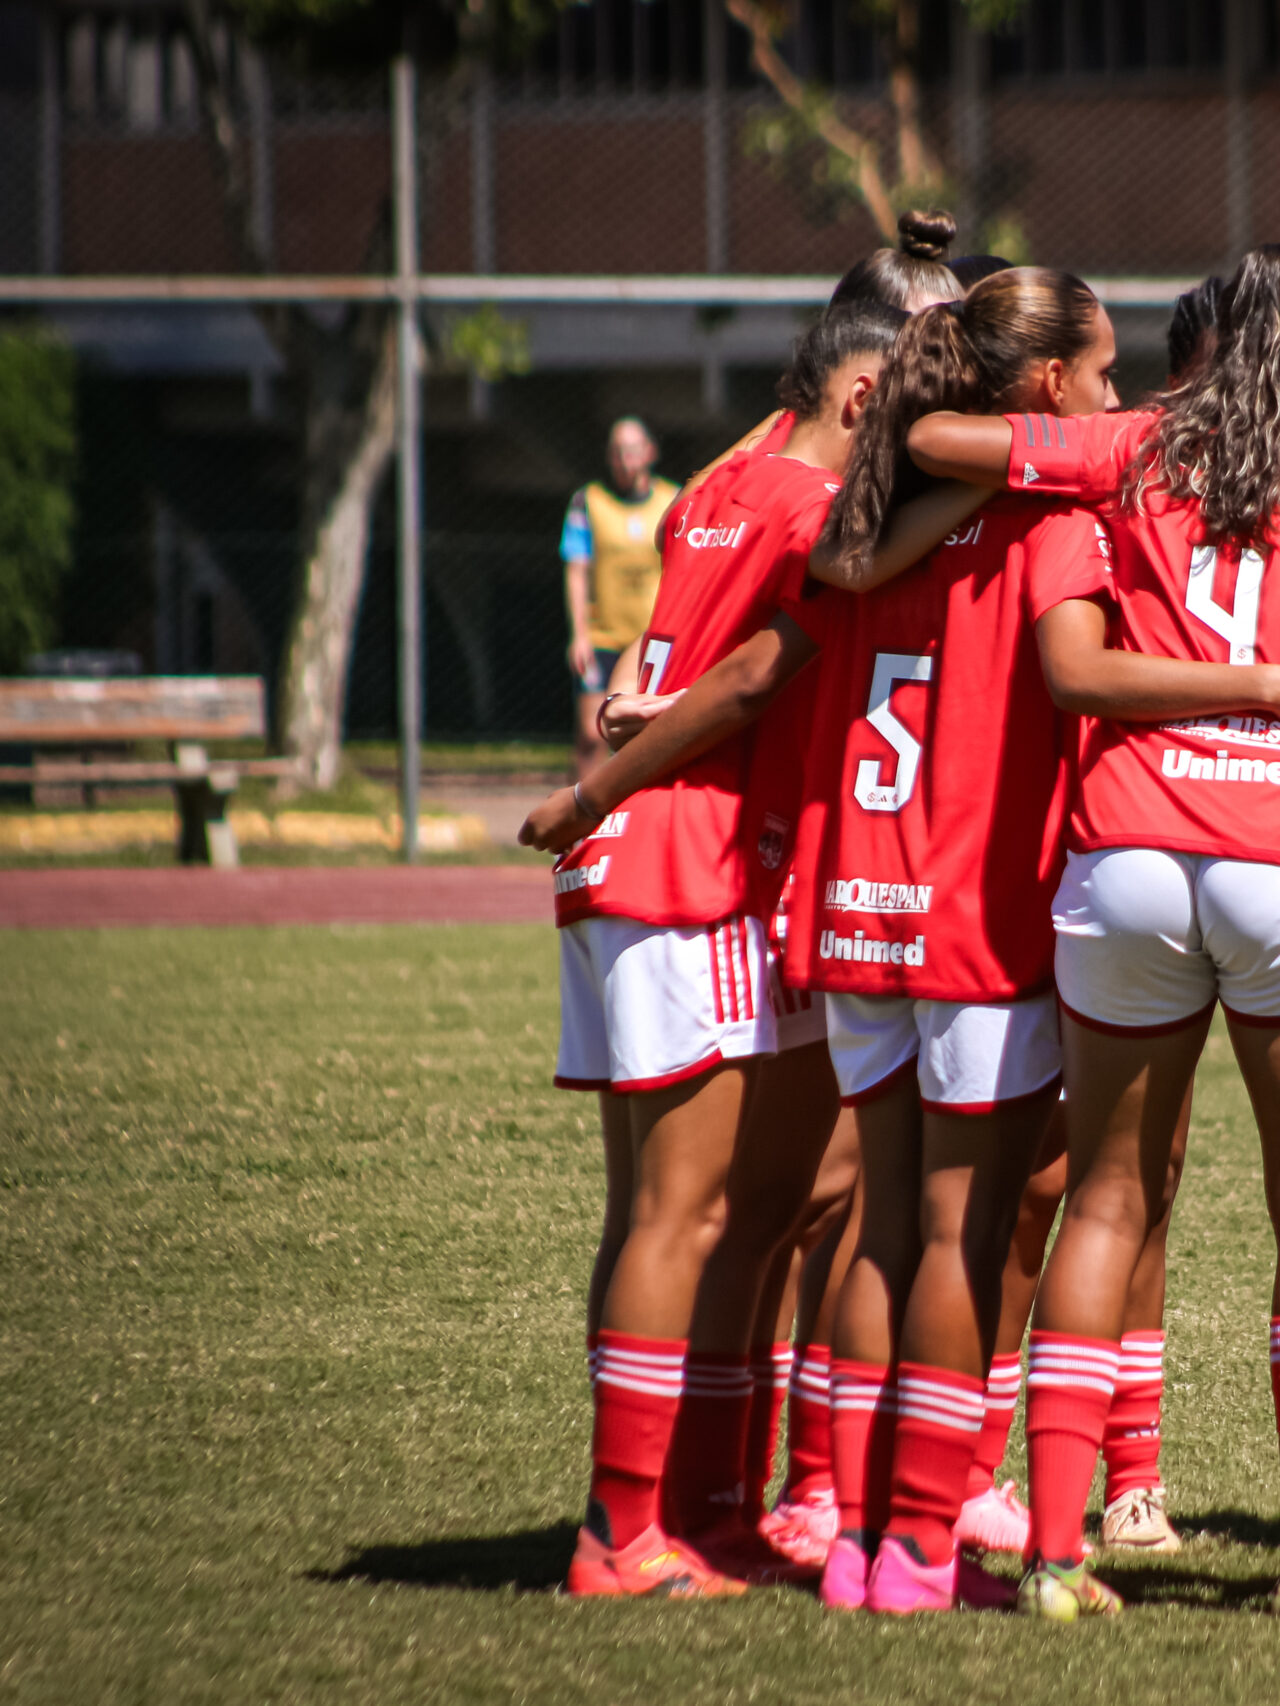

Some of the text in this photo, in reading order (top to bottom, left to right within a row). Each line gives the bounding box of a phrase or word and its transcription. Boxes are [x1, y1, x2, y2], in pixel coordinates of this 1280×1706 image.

[1184, 545, 1265, 667] 4
[853, 652, 933, 812] 5
[820, 929, 926, 967] Unimed
